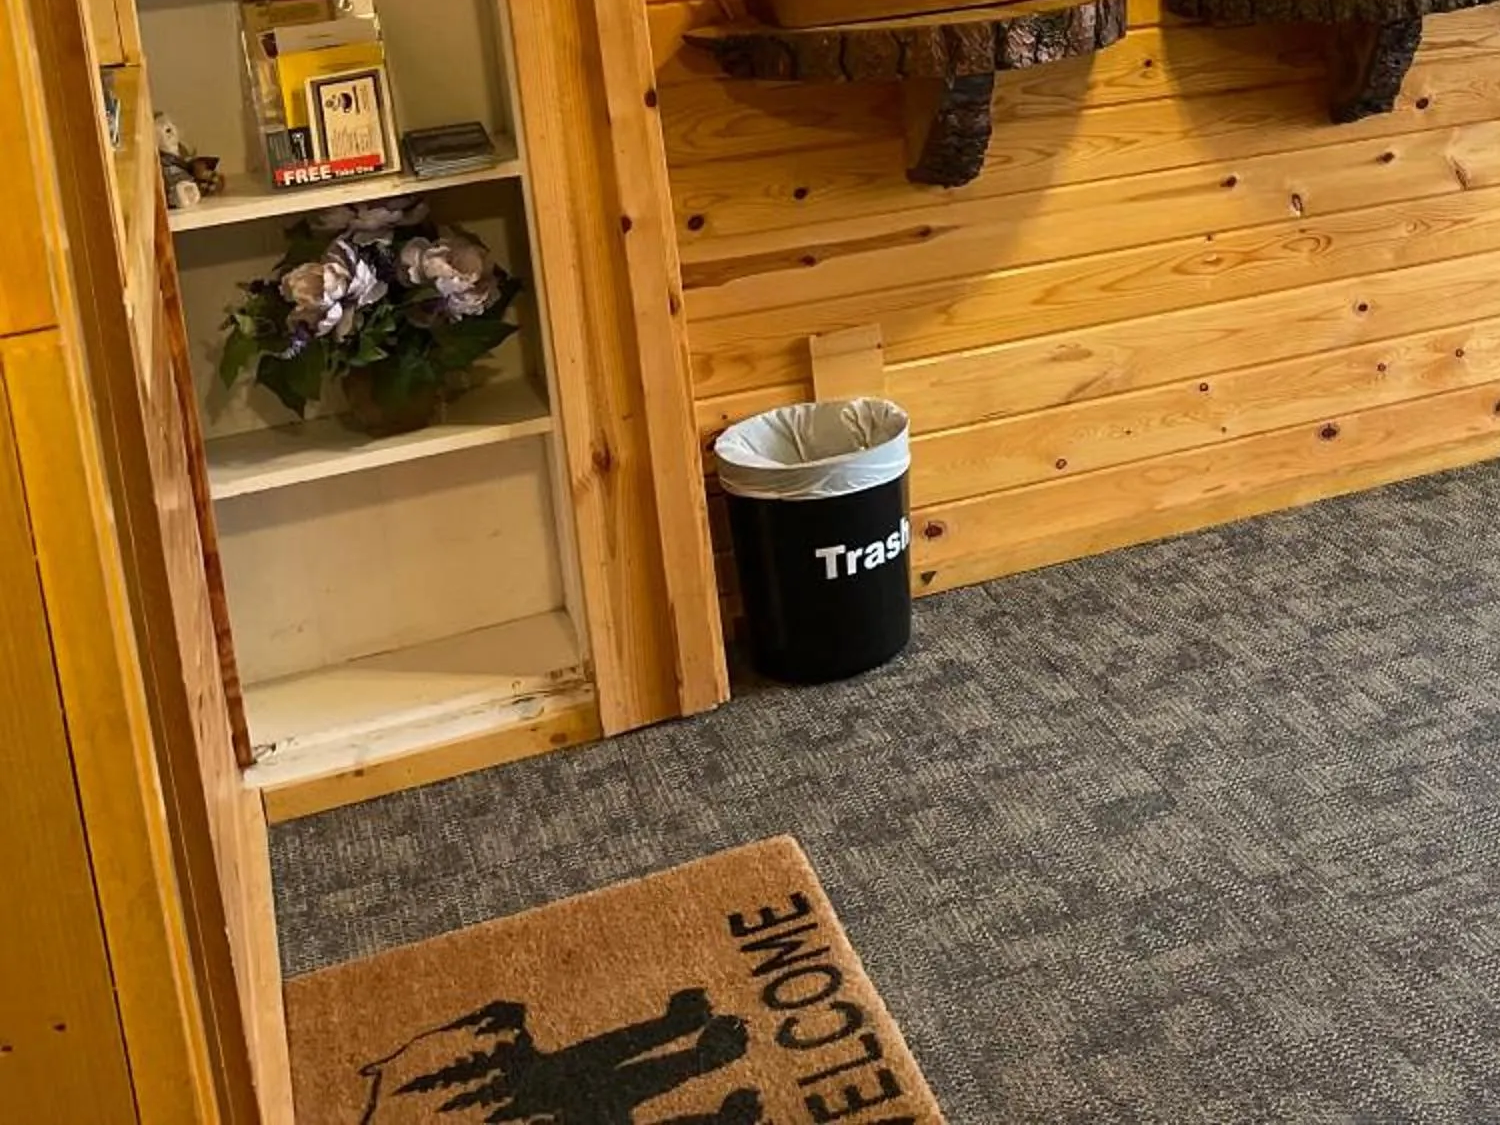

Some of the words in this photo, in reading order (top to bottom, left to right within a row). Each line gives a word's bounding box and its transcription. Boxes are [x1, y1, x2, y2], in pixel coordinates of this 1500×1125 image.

[283, 164, 332, 186] FREE
[814, 516, 911, 580] Trash
[728, 890, 916, 1125] ELCOME
